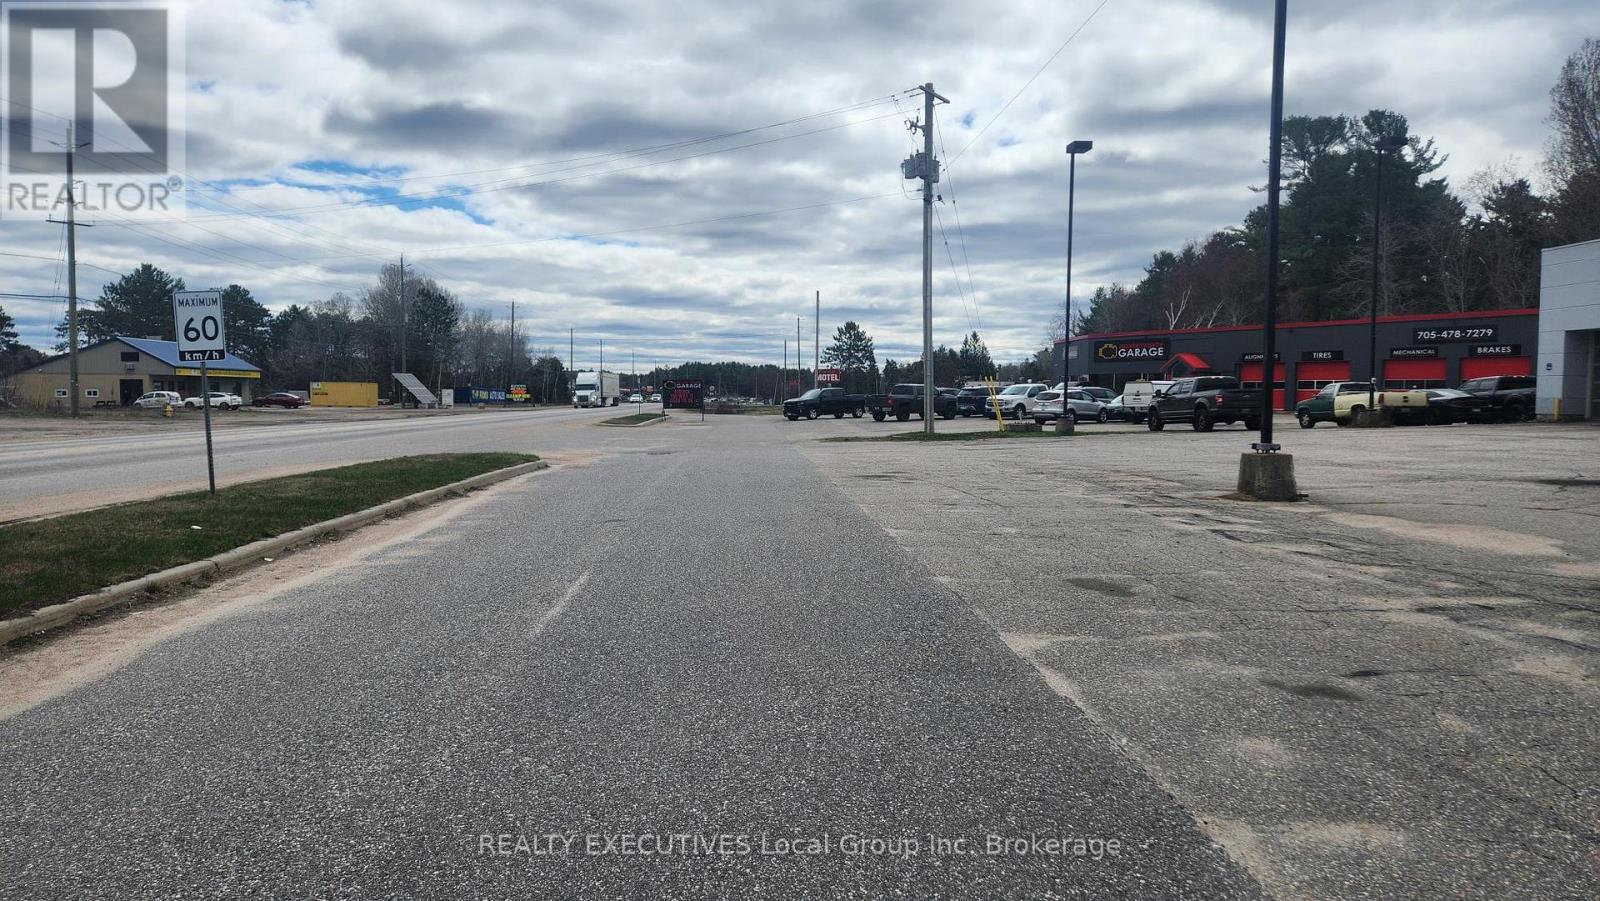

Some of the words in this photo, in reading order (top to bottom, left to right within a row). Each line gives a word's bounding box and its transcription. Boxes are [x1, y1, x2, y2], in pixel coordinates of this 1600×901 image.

[178, 298, 218, 307] MAXIMUM
[184, 316, 219, 342] 60
[1417, 329, 1494, 339] 705-478-7279
[185, 351, 219, 360] km/h
[1118, 347, 1164, 358] GARAGE
